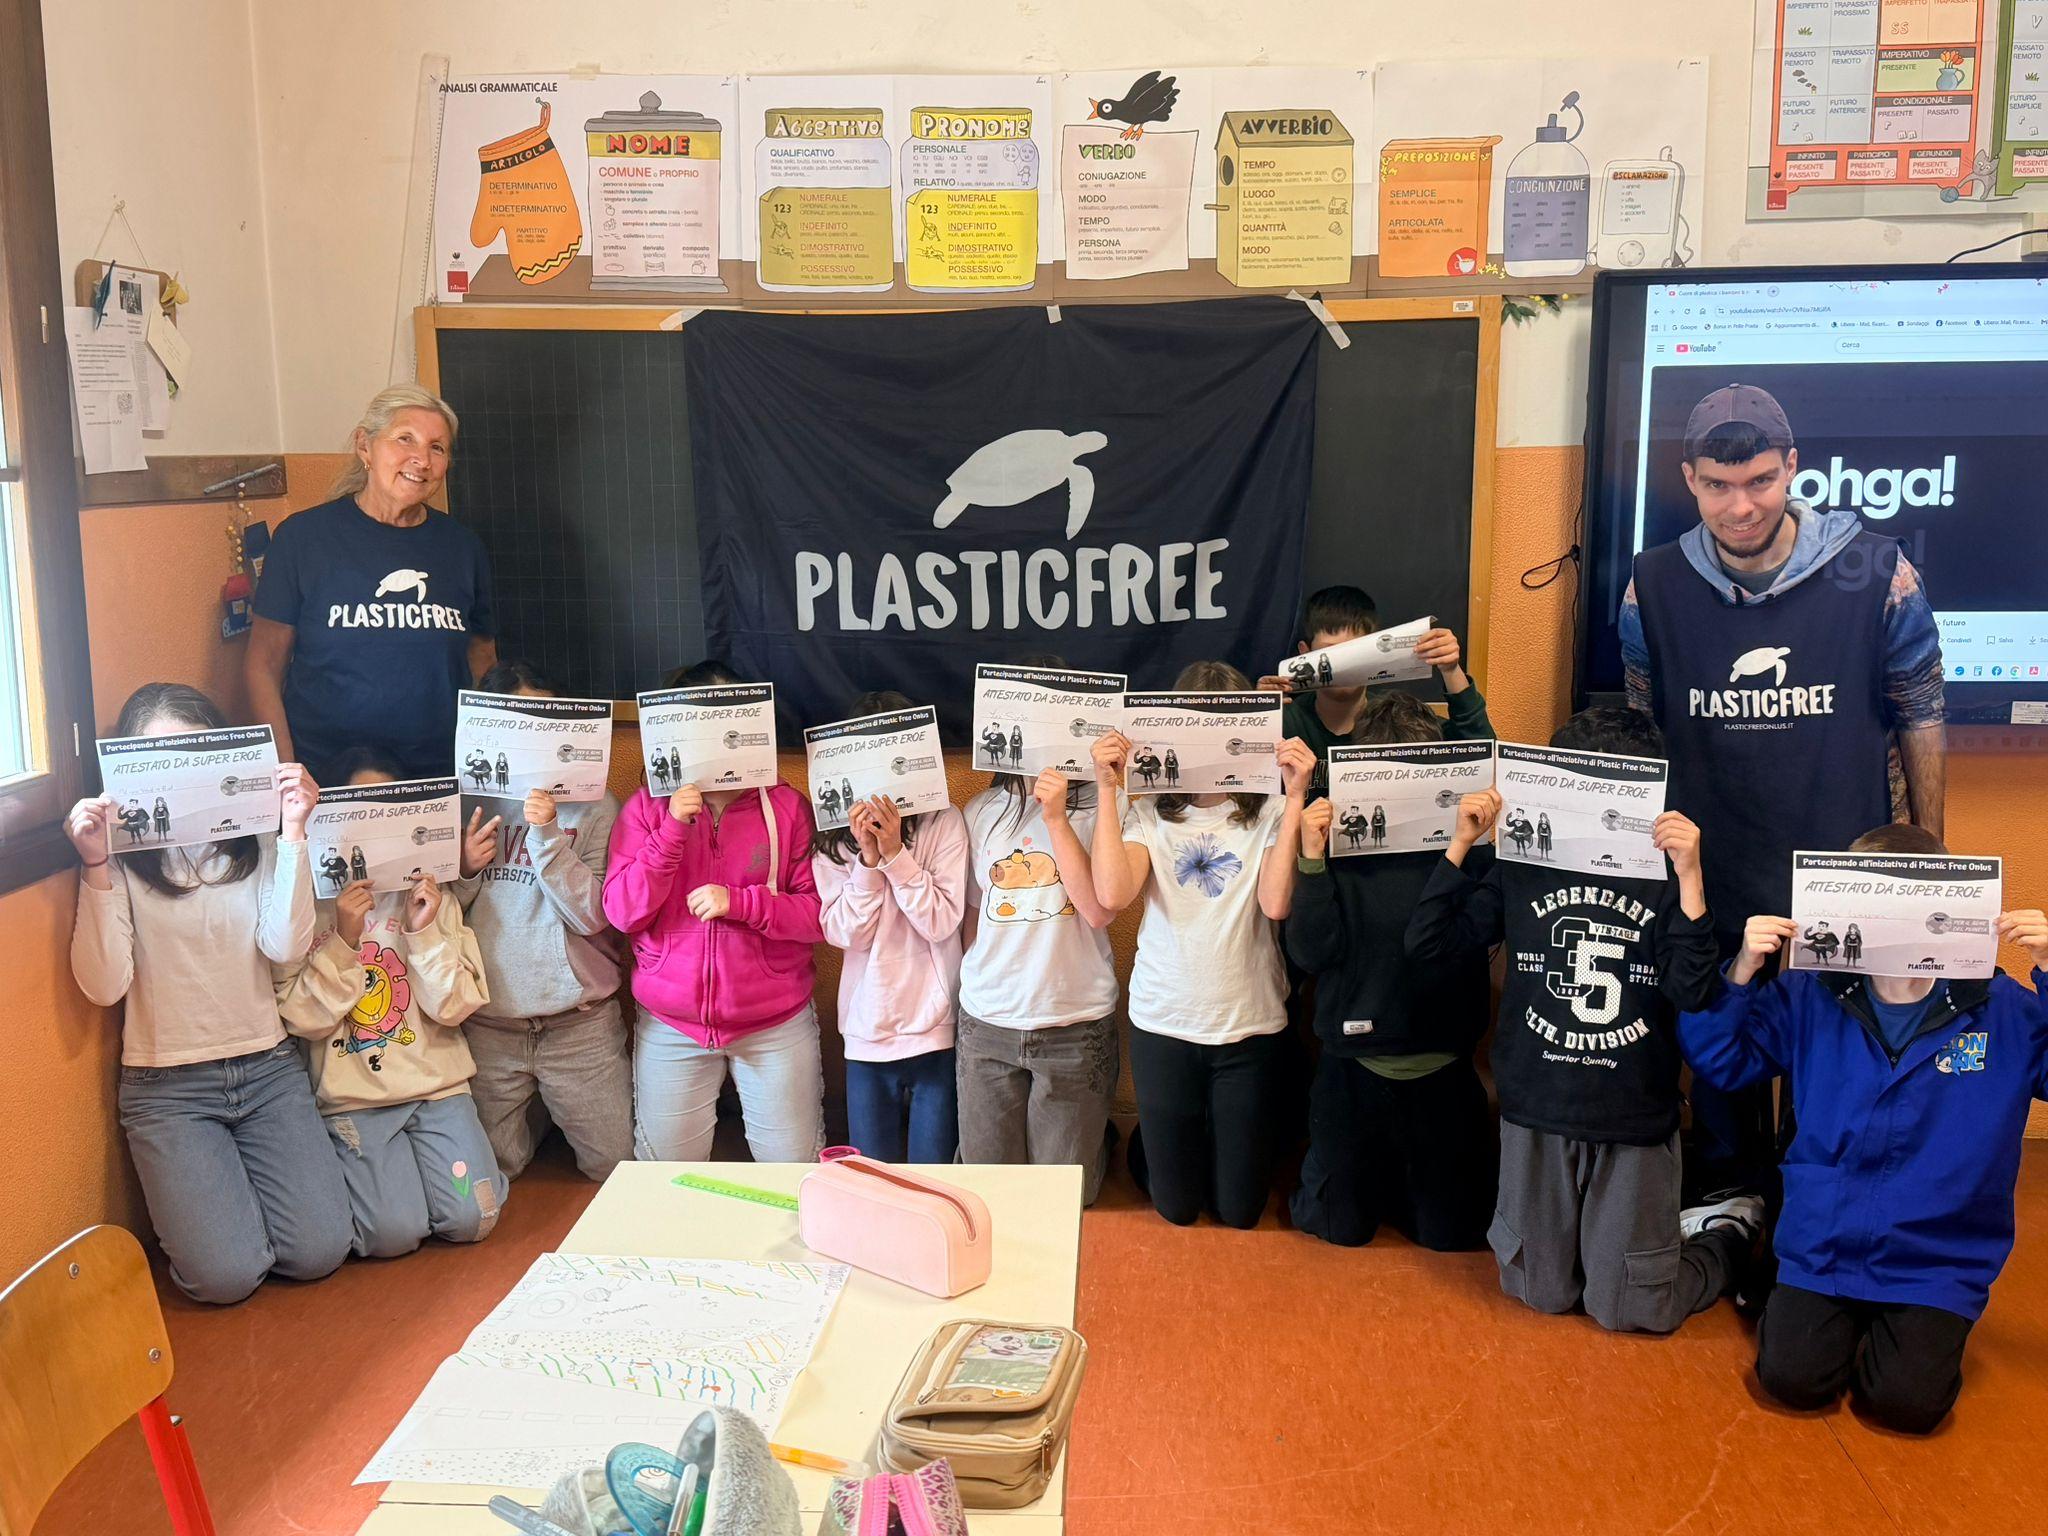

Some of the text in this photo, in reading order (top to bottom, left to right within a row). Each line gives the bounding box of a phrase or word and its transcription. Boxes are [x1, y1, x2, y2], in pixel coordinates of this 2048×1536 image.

[1832, 48, 1875, 56] TRAPASSATO
[1882, 50, 1930, 58] IMPERATIVO
[438, 82, 558, 93] ANALISI GRAMMATICALE
[1893, 96, 1953, 105] CONDIZIONALE
[607, 134, 690, 156] NOME
[912, 145, 967, 154] PERSONALE
[770, 148, 835, 158] QUALIFICATIVO
[1078, 144, 1136, 160] VERBO
[1854, 150, 1890, 158] PARTICIPIO
[490, 143, 546, 172] ARTICOLO
[1394, 152, 1477, 163] PREPOSIZIONE
[1243, 161, 1276, 169] TEMPO
[599, 166, 652, 178] COMUNE
[660, 169, 700, 178] PROPRIO
[1078, 171, 1147, 181] CONIUGAZIONE
[490, 182, 558, 190] DETERMINATIVO
[914, 178, 956, 186] RELATIVO
[1509, 178, 1586, 194] CONGIUNZIONE
[800, 194, 848, 202] NUMERALE
[948, 194, 997, 202] NUMERALE
[1078, 194, 1107, 203] MODO
[1242, 190, 1276, 198] LUOGO
[1390, 189, 1437, 198] SEMPLICE
[490, 204, 567, 213] INDETERMINATIVO
[774, 204, 792, 214] 123
[921, 204, 938, 214] 123
[1078, 216, 1110, 225] TEMPO
[1388, 218, 1444, 227] ARTICOLATA
[800, 222, 848, 230] INDEFINITO
[948, 222, 997, 230] INDEFINITO
[1242, 222, 1287, 232] QUANTITÀ
[800, 244, 864, 252] DIMOSTRATIVO
[948, 244, 1013, 252] DIMOSTRATIVO
[1078, 239, 1122, 248] PERSONA
[1242, 246, 1270, 254] MODO
[800, 264, 855, 272] POSSESSIVO
[948, 264, 1004, 272] POSSESSIVO
[1690, 344, 1716, 352] YouTube
[1790, 455, 1956, 520] ohga!
[795, 538, 1230, 632] PLASTICFREE
[328, 603, 466, 632] PLASTICFREE
[983, 689, 1113, 708] ATTESTATO DA SUPER EROE
[1689, 684, 1836, 718] PLASTICFREE
[646, 706, 762, 726] ATTESTATO DA SUPER EROE
[466, 716, 600, 734] ATTESTATO DA SUPER EROE
[1132, 716, 1269, 727] ATTESTATO DA SUPER EROE
[814, 730, 926, 760] ATTESTATO DA SUPER EROE
[113, 750, 262, 775] ATTESTATO DA SUPER EROE
[1589, 758, 1596, 766] di
[1598, 760, 1620, 770] Plastic
[1622, 763, 1638, 772] Free
[1639, 764, 1660, 774] Onlus
[1338, 766, 1480, 783] ATTESTATO DA SUPER EROE
[1505, 770, 1650, 799] ATTESTATO DA SUPER EROE
[314, 802, 450, 824] ATTESTATO DA SUPER EROE
[1591, 860, 1622, 870] PLASTICFREE
[1802, 858, 1858, 868] Partecipando
[1909, 860, 1917, 869] di
[1918, 860, 1946, 870] Plastic
[1948, 862, 1967, 871] Free
[1968, 862, 1992, 872] Onlus
[1804, 880, 1984, 898] ATTESTATO DA SUPER EROE
[1530, 886, 1656, 928] LEGENDARY
[1594, 924, 1636, 940] VINTAGE
[1516, 952, 1545, 962] WORLD
[1518, 962, 1544, 973] CLASS
[1630, 963, 1658, 974] URBA
[1908, 962, 1944, 970] PLASTICFREE
[1629, 974, 1658, 986] STYLE
[1564, 1017, 1650, 1051] DIVISION
[1542, 1050, 1618, 1069] Superior Quality
